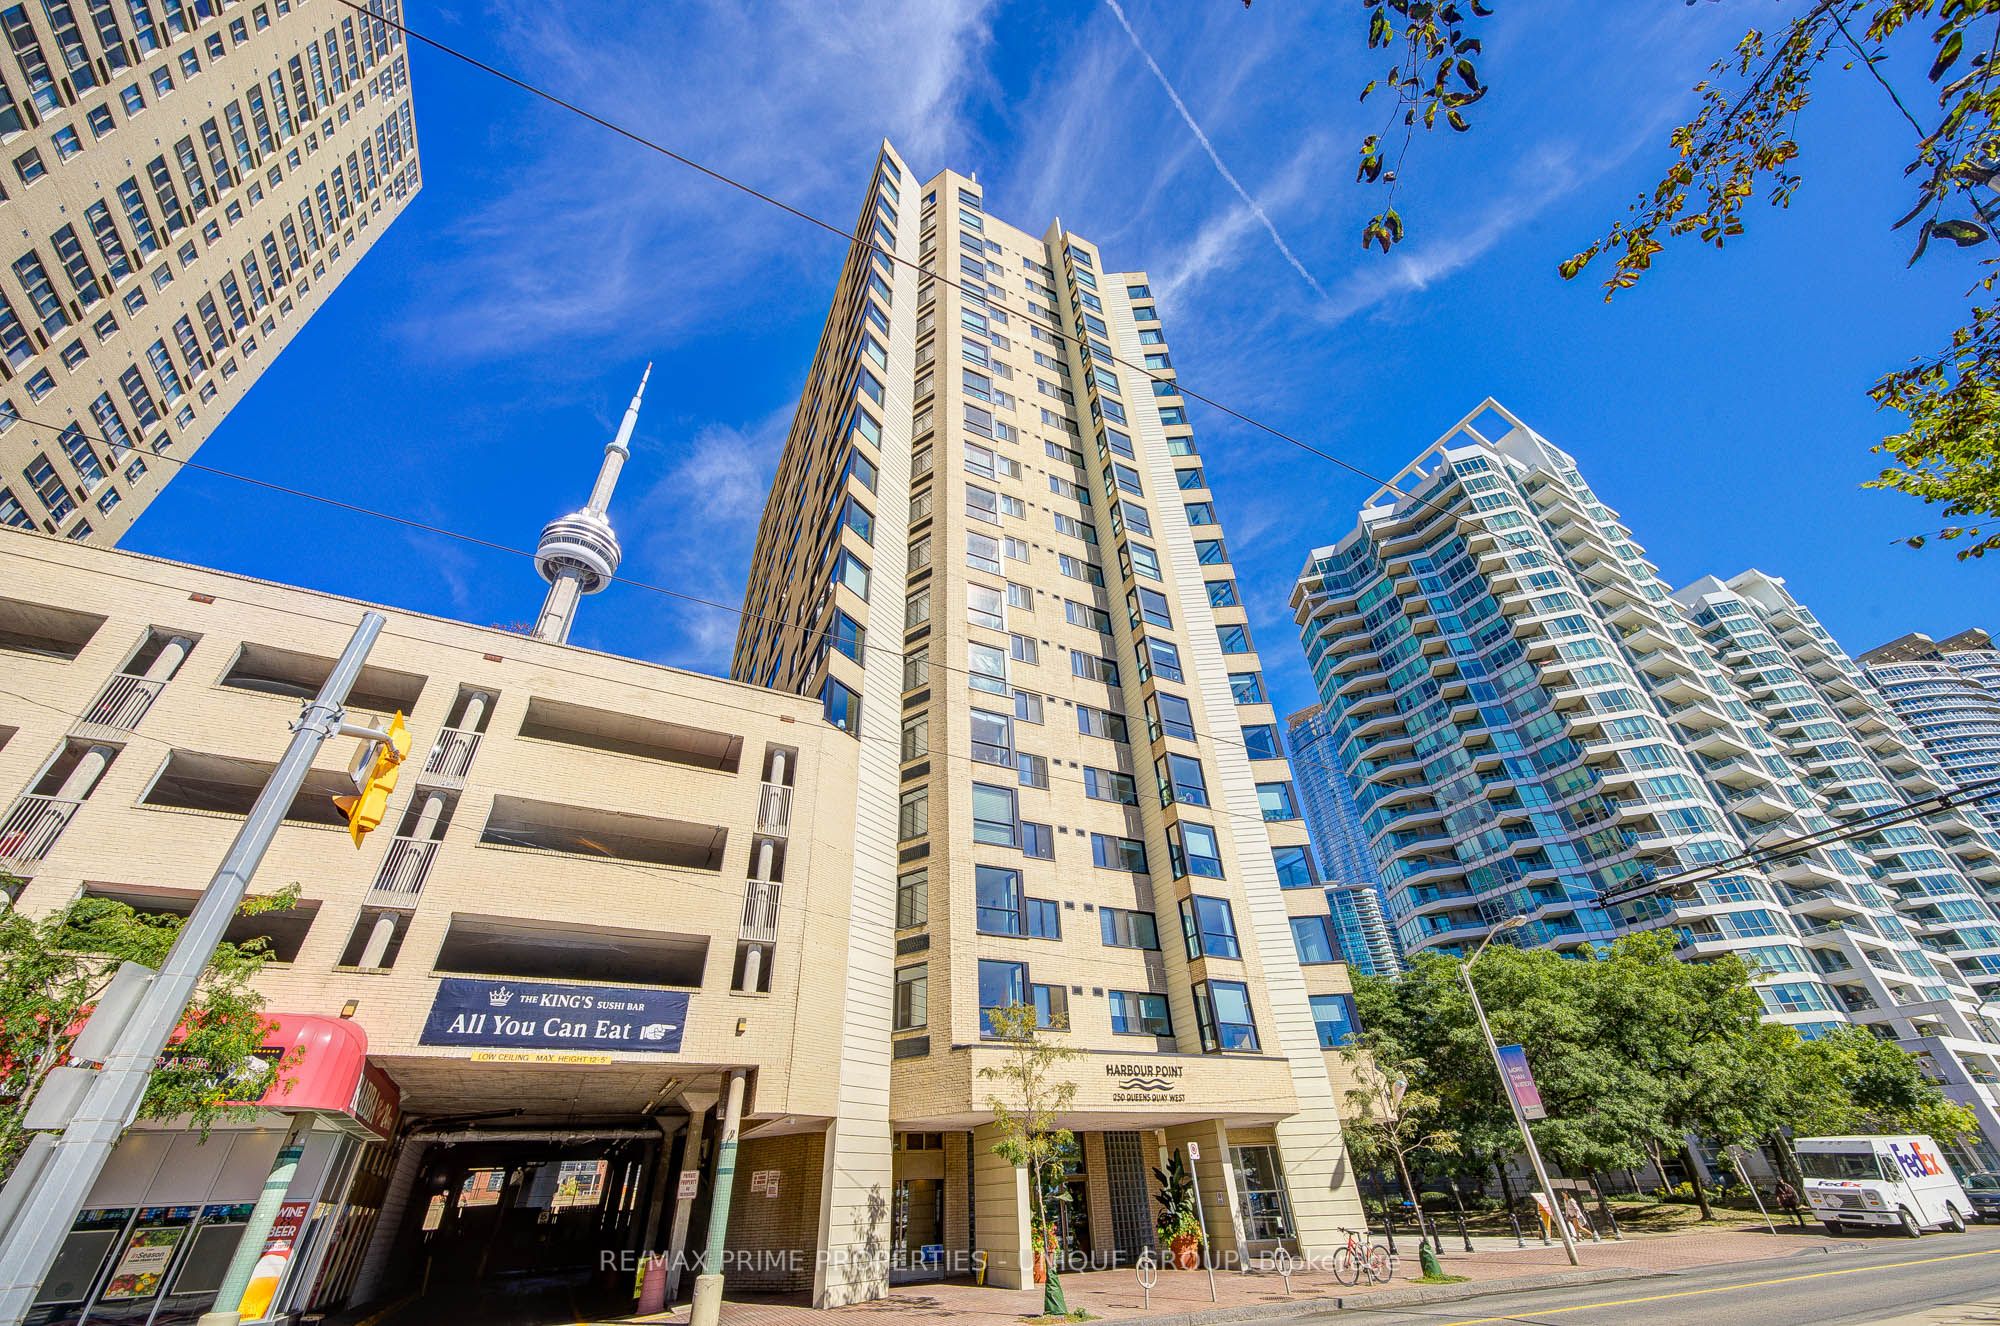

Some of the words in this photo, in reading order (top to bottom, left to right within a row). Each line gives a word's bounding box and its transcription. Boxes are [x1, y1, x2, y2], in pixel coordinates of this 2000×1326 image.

[519, 995, 538, 1004] THE
[539, 993, 593, 1009] KING'S
[597, 1001, 625, 1011] SUSHI
[626, 1002, 645, 1011] BAR
[447, 1013, 486, 1034] All
[492, 1015, 536, 1036] You
[543, 1018, 587, 1038] Can
[593, 1020, 632, 1040] Eat
[478, 1053, 496, 1061] LOW
[498, 1053, 529, 1062] CEILING
[558, 1055, 588, 1063] HEIGHT
[1106, 1064, 1153, 1077] HARBOUR
[1156, 1065, 1183, 1078] POINT
[1113, 1093, 1125, 1102] 250
[1126, 1093, 1151, 1102] QUEENS
[1152, 1093, 1168, 1102] QUAY
[1169, 1094, 1185, 1102] WEST
[1889, 1142, 1943, 1179] FedEx
[1818, 1180, 1862, 1188] FedEx
[279, 1206, 306, 1218] WINE
[268, 1225, 297, 1237] BEER
